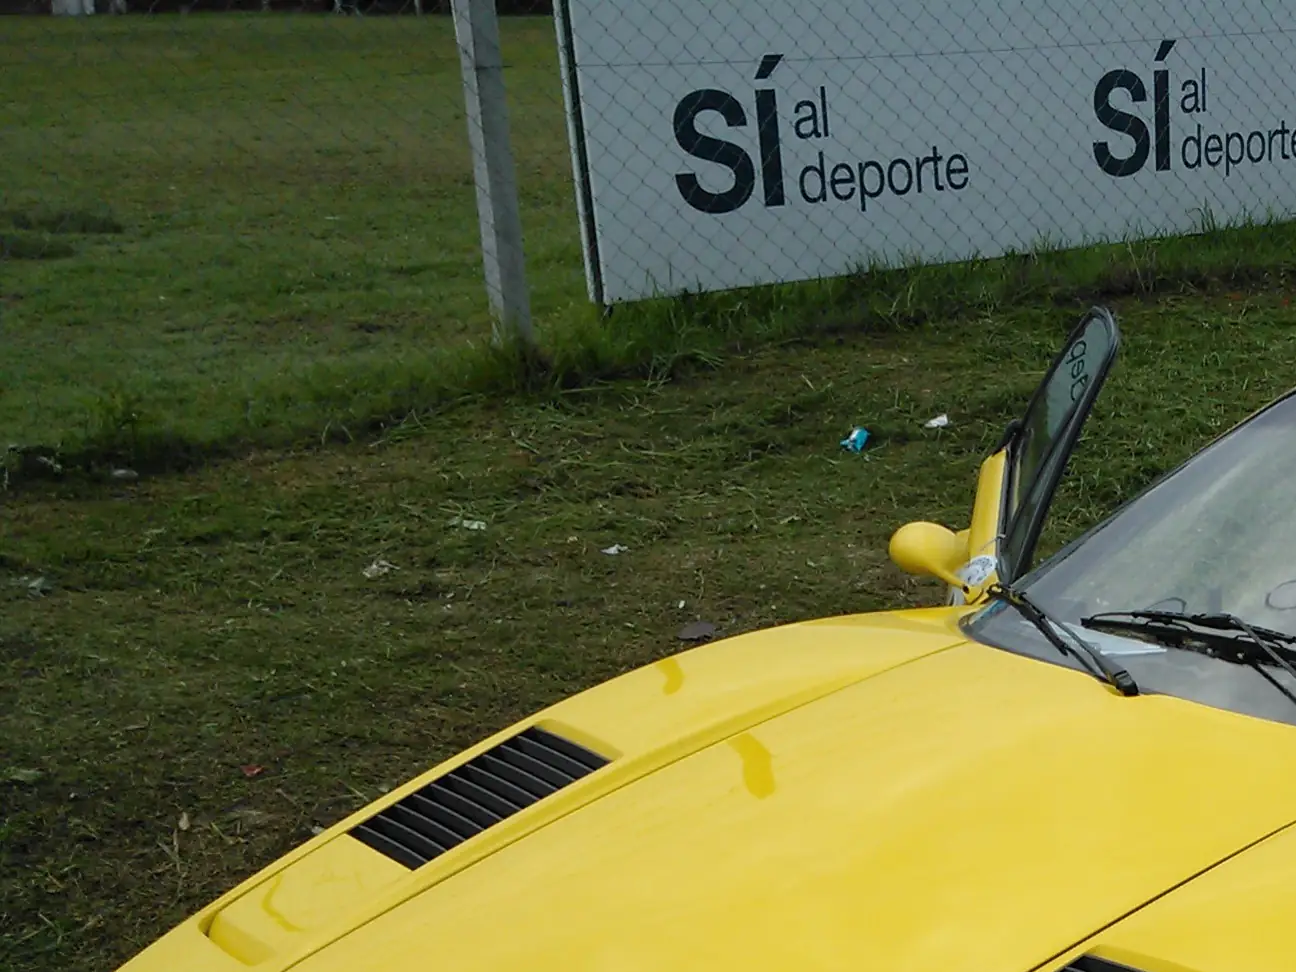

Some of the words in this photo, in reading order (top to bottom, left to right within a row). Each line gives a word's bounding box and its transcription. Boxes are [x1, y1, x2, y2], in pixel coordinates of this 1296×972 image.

[672, 53, 786, 215] SÍ
[793, 85, 830, 140] al
[1092, 39, 1178, 178] SÍ
[1180, 67, 1208, 114] al
[798, 144, 969, 214] deporte
